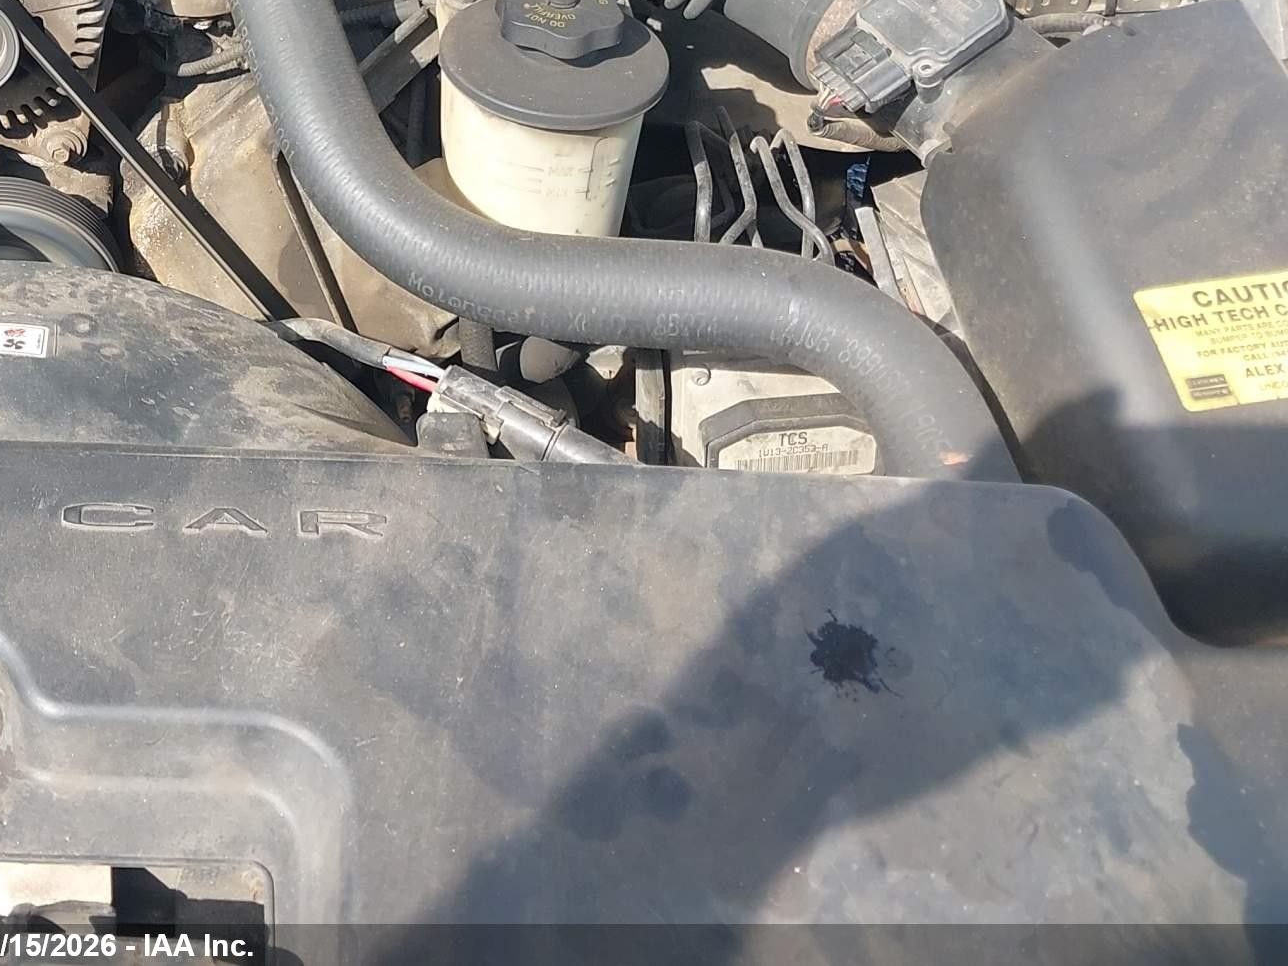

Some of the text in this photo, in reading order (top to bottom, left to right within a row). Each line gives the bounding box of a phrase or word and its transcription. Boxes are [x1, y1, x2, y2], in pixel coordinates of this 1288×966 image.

[524, 13, 566, 28] DO NOT
[1152, 313, 1209, 332] HIGH
[1212, 305, 1270, 324] TECH
[1196, 349, 1218, 359] FOR
[1221, 343, 1267, 355] FACTORY
[1245, 363, 1286, 379] ALEX
[778, 431, 808, 447] TCS
[60, 502, 389, 539] CAR
